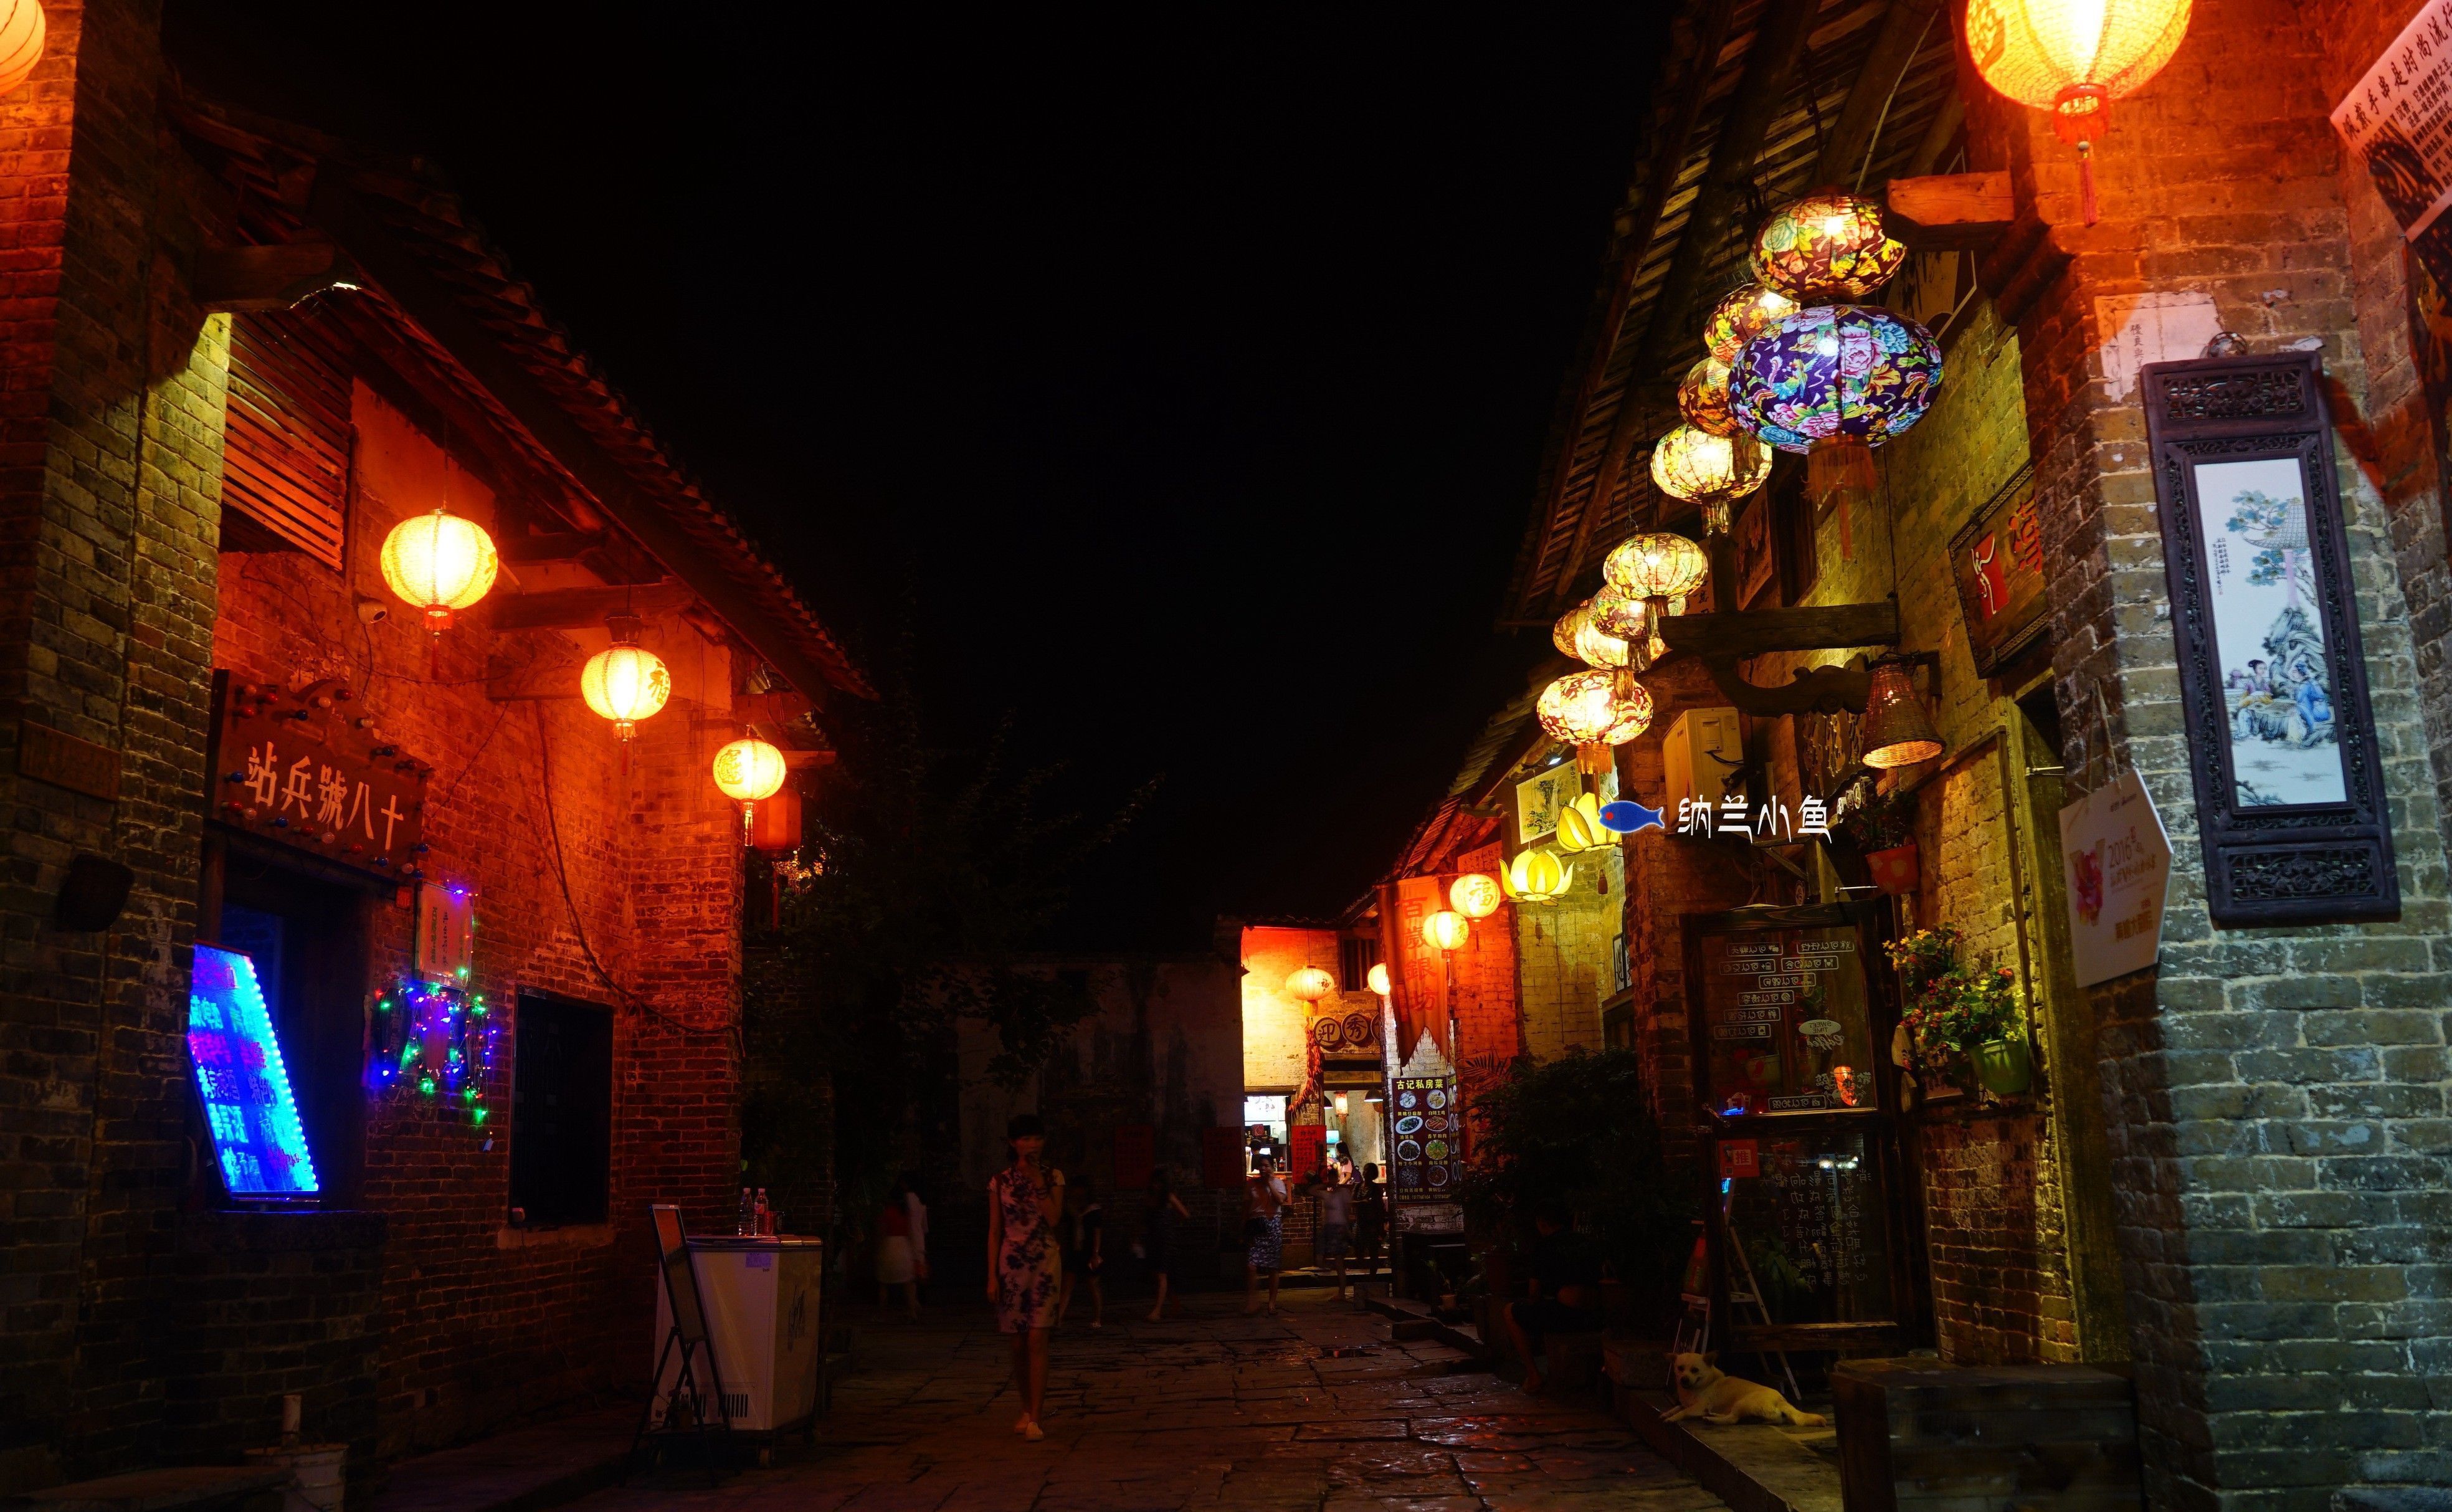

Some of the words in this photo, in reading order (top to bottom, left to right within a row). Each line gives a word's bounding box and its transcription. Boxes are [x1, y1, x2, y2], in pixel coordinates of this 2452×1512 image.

[1396, 1079, 1443, 1090] 古记私房菜
